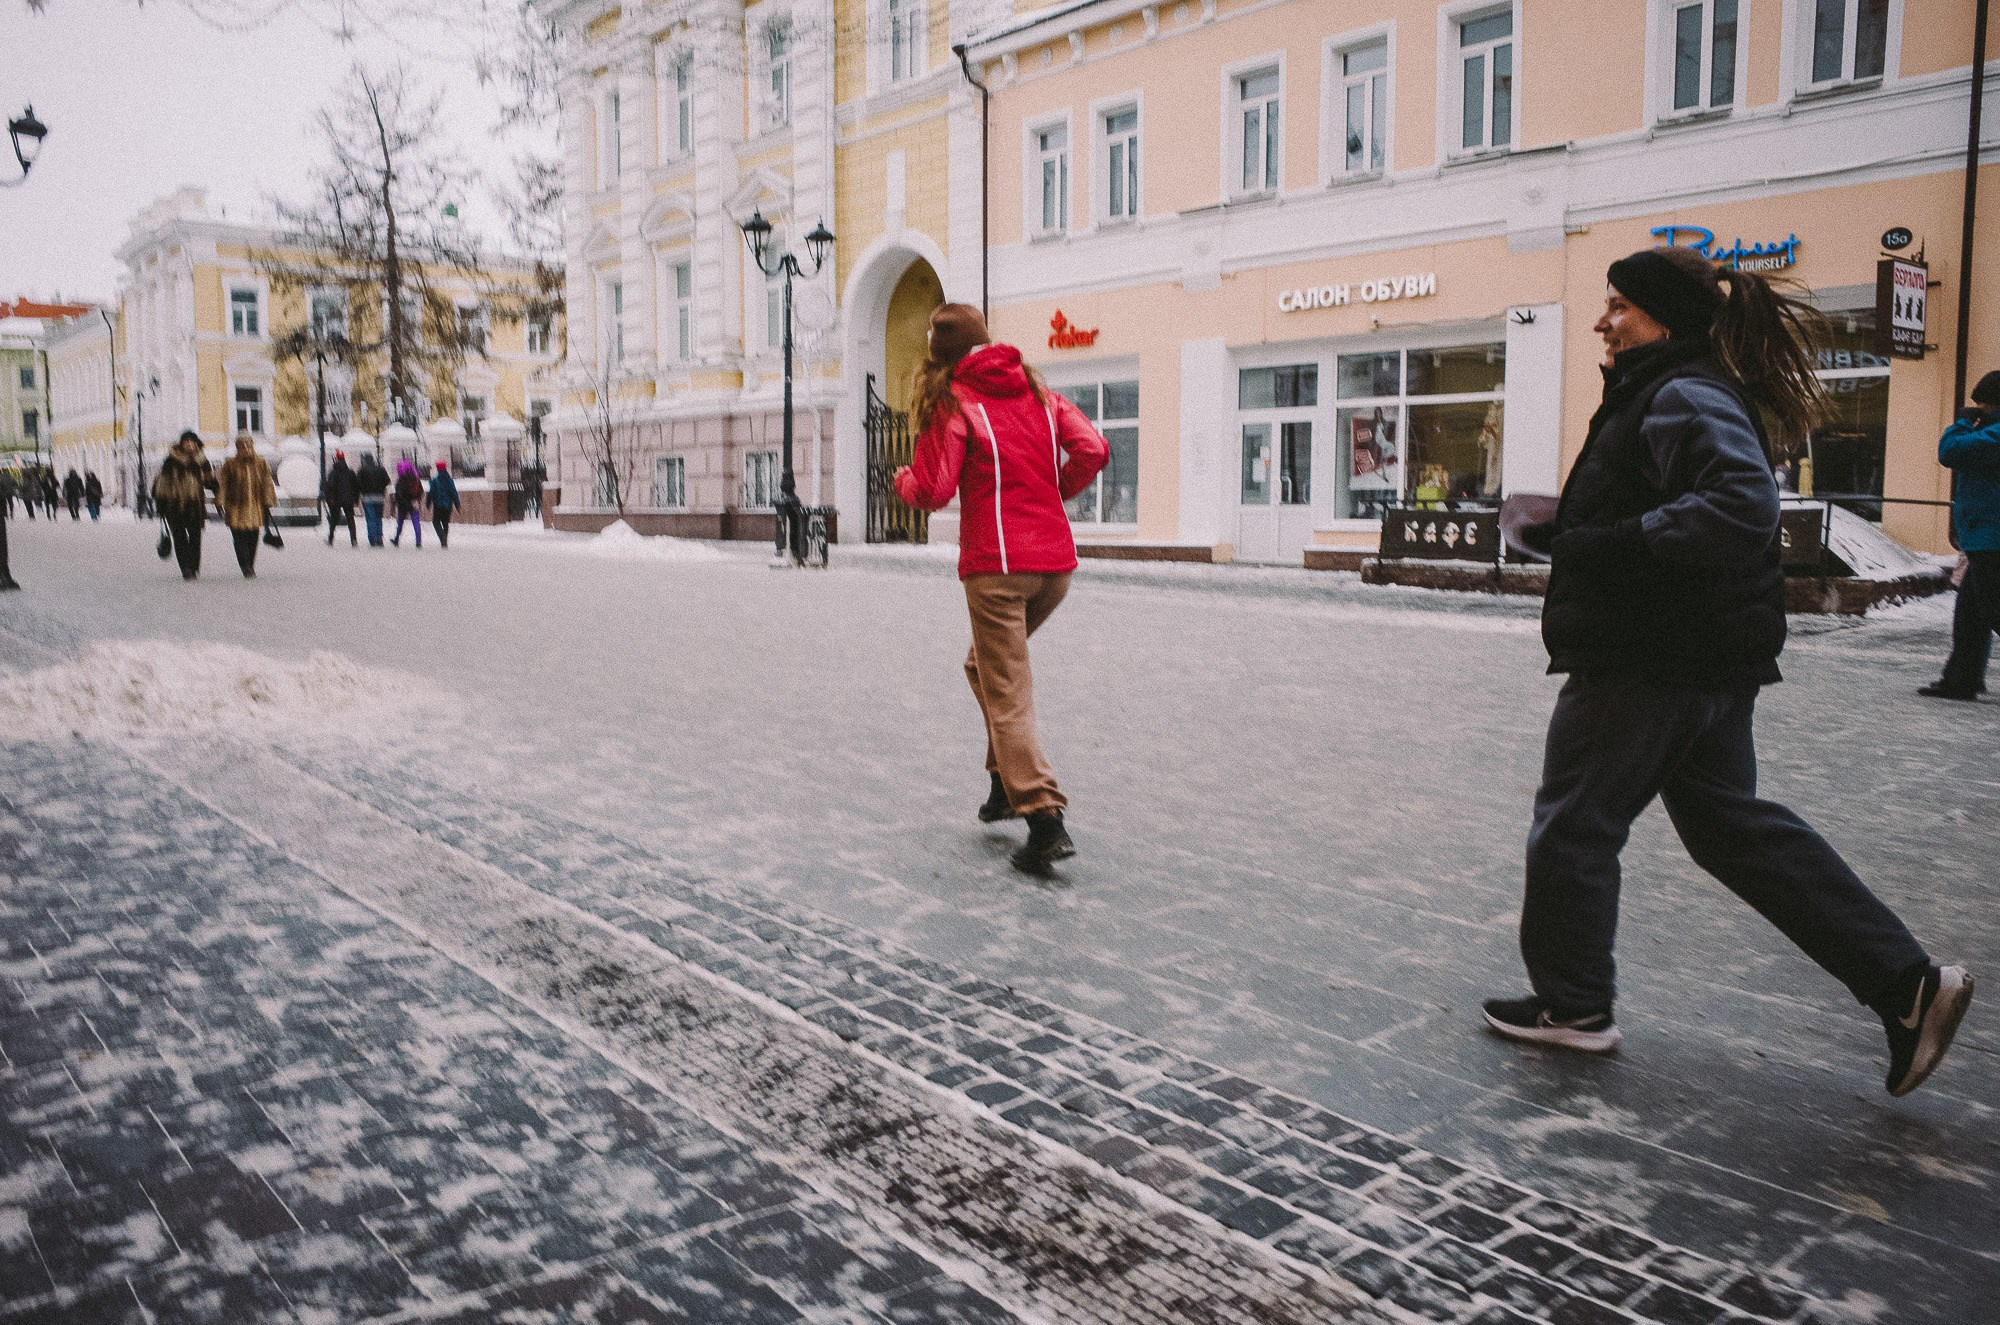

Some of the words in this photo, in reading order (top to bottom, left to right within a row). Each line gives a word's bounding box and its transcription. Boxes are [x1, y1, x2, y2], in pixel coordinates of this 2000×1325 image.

[1738, 256, 1789, 271] YOURSELF
[1278, 283, 1350, 313] САЛОН
[1360, 272, 1438, 303] ОБУВИ
[1404, 520, 1477, 549] КАФЕ
